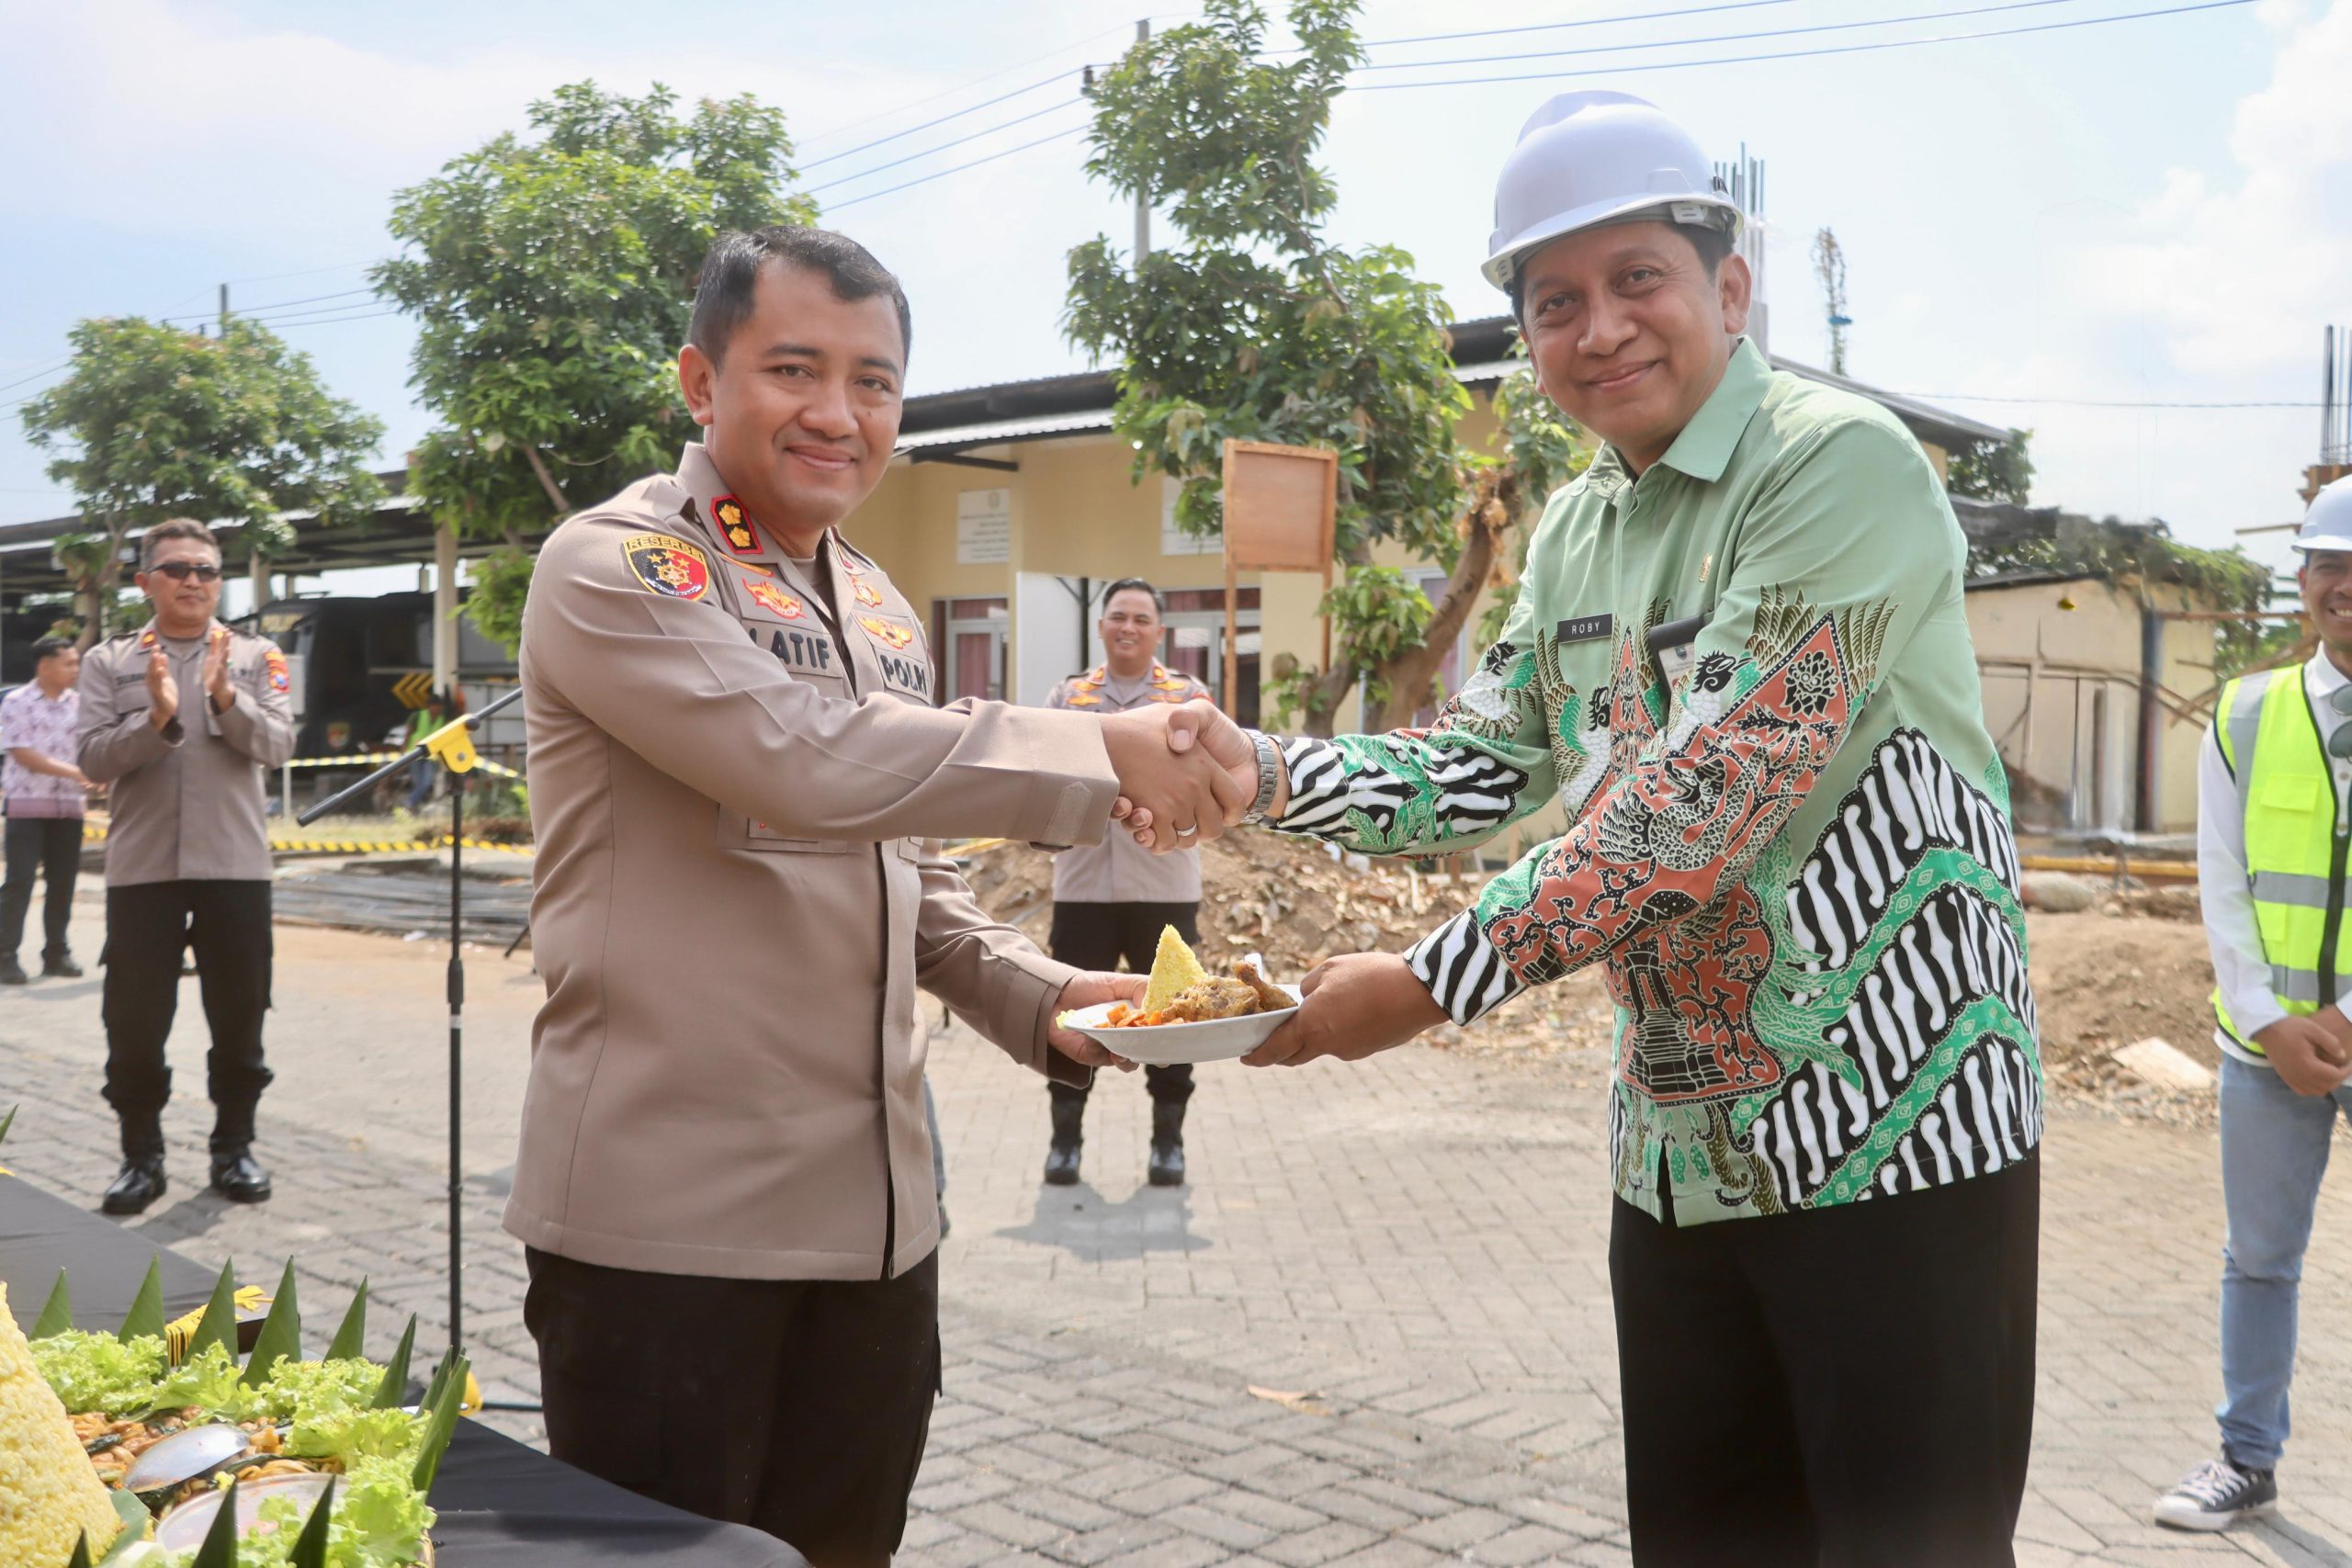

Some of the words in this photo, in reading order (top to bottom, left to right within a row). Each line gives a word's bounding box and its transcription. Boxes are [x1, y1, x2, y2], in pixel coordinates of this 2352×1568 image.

[627, 536, 704, 561] RESERSE
[1571, 622, 1600, 635] ROBY
[879, 654, 928, 696] POLRI
